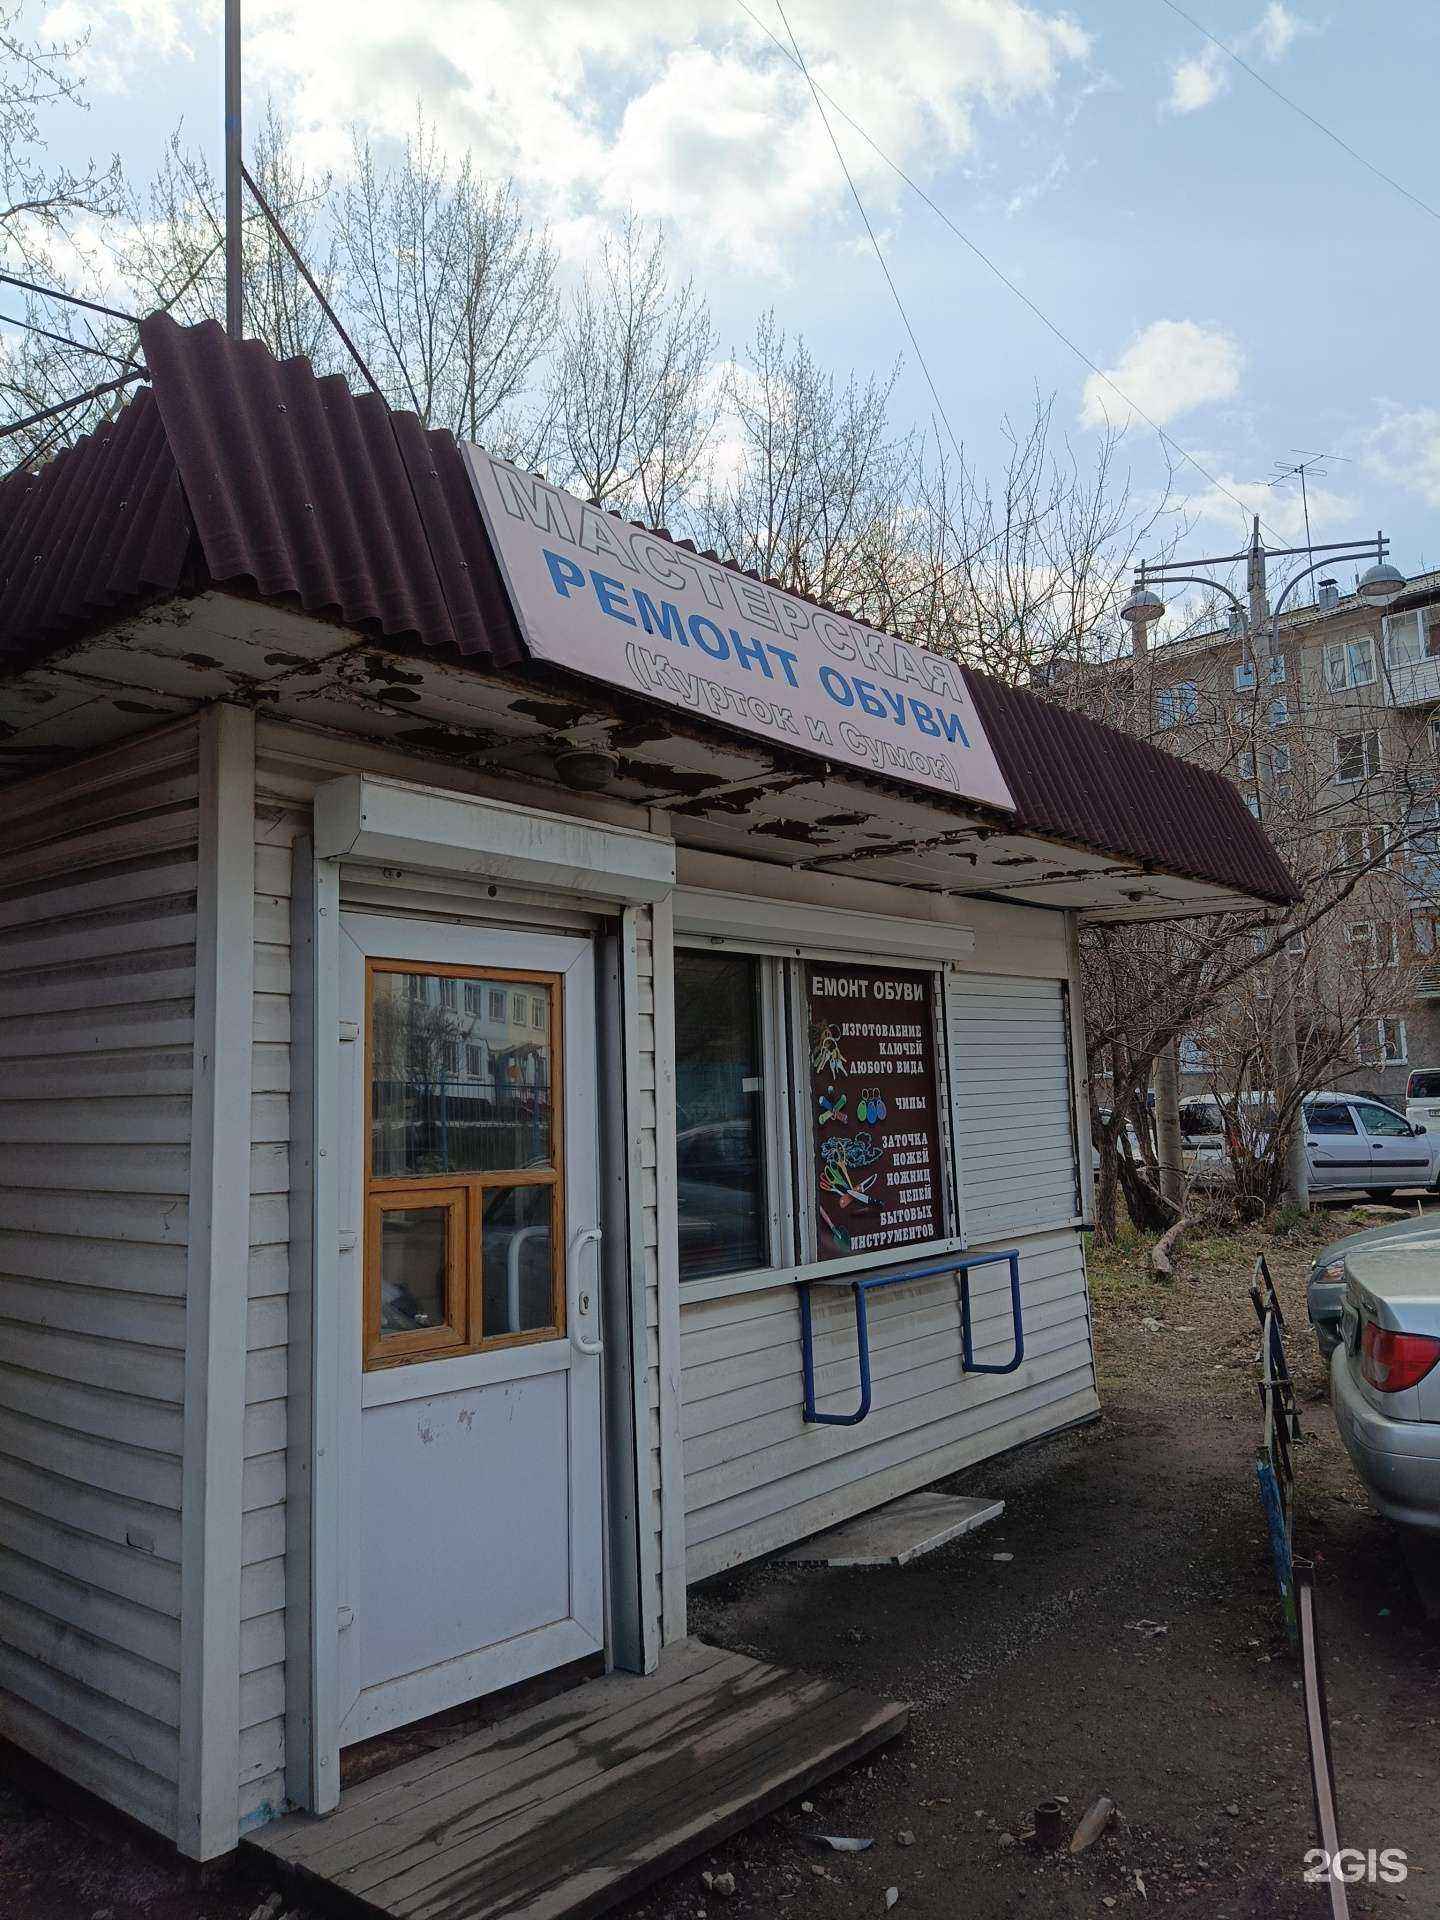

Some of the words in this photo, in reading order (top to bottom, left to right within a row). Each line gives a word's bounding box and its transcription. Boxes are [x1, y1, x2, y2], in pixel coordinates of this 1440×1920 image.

[489, 459, 963, 703] МАСТЕРСКАЯ
[542, 549, 800, 688] РЕМОНТ
[818, 664, 971, 748] ОБУВИ
[625, 641, 800, 736] (Курток
[804, 715, 834, 746] и
[838, 721, 961, 792] Сумок)
[812, 976, 868, 998] ЕМОНТ
[873, 980, 924, 1001] ОБУВИ
[842, 1022, 922, 1037] ИЗГОТОВЛЕНИЕ
[879, 1039, 923, 1055] КЛЮЧЕЙ
[850, 1060, 893, 1074] ЛЮБОГО
[896, 1060, 924, 1075] ВИДА
[895, 1096, 926, 1110] ЧИПЫ
[881, 1132, 928, 1149] ЗАТОЧКА
[893, 1146, 930, 1166] НОЖЕЙ
[886, 1168, 931, 1186] НОЖНИЦ
[899, 1183, 932, 1205] ЦЕПЕЙ
[880, 1204, 933, 1226] БЫТОВЫХ
[850, 1223, 934, 1251] ИНСТРУМЕНТОВ
